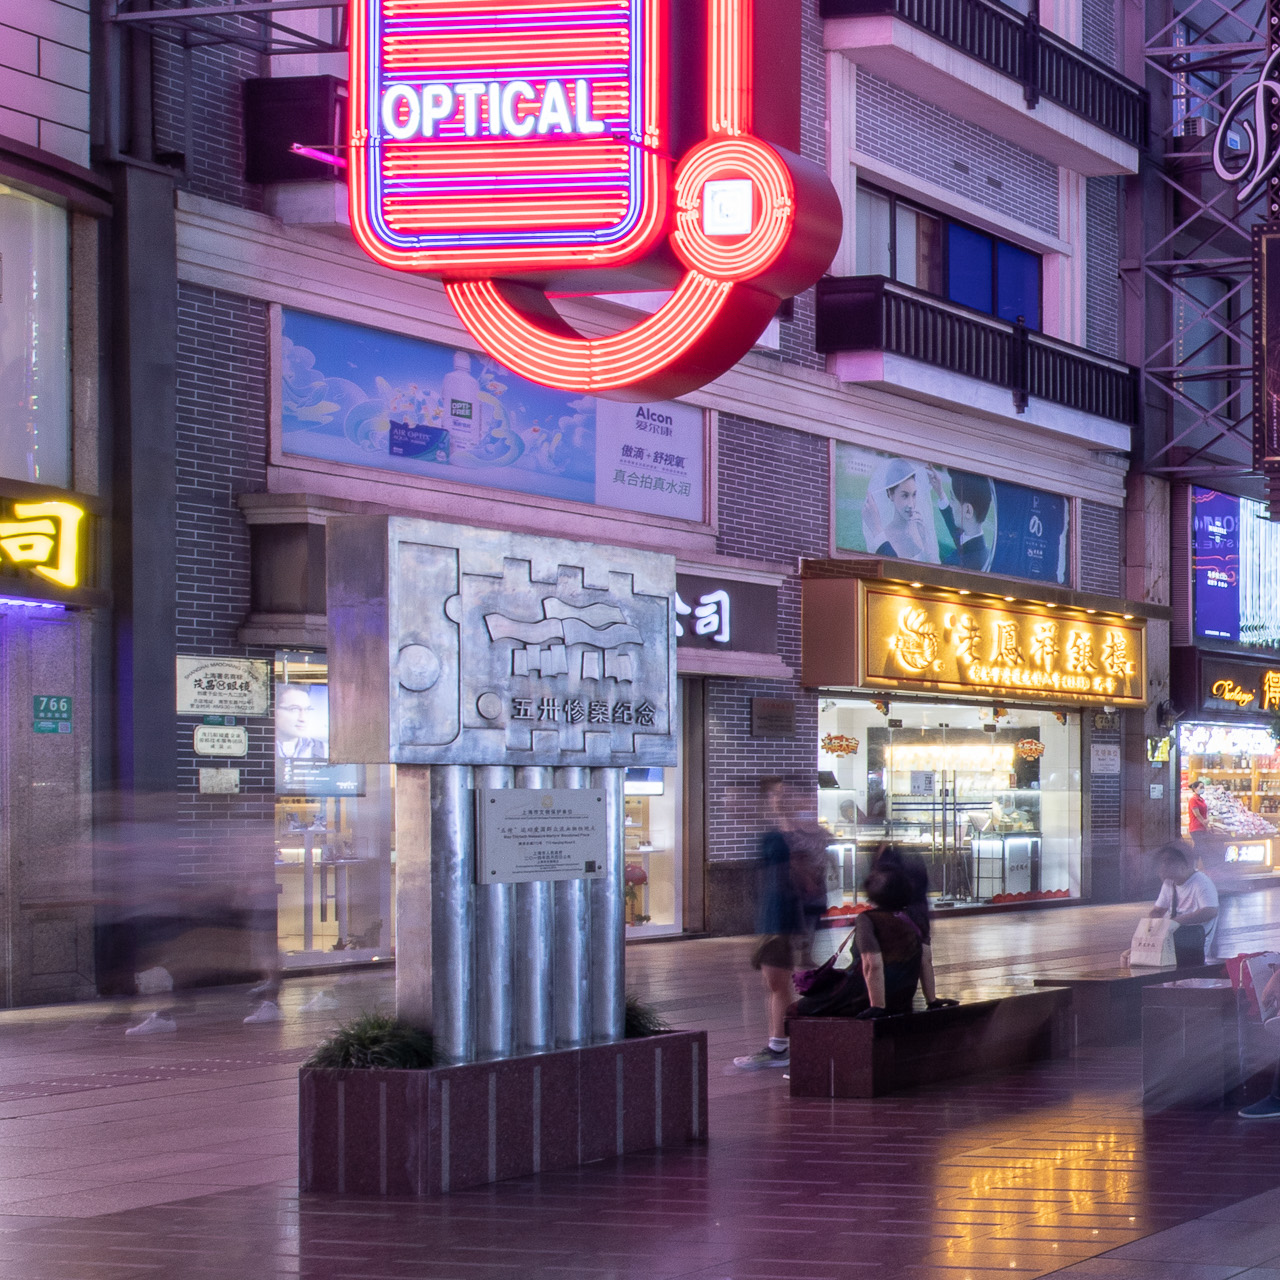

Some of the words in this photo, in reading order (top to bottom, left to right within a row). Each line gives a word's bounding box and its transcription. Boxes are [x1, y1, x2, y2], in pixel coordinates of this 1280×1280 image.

[382, 77, 607, 138] OPTICAL
[635, 406, 673, 425] Alcon
[635, 420, 673, 437] 爱尔康
[613, 469, 691, 497] 真合拍真水润
[39, 697, 68, 711] 766
[512, 697, 656, 726] 五卅惨案纪念
